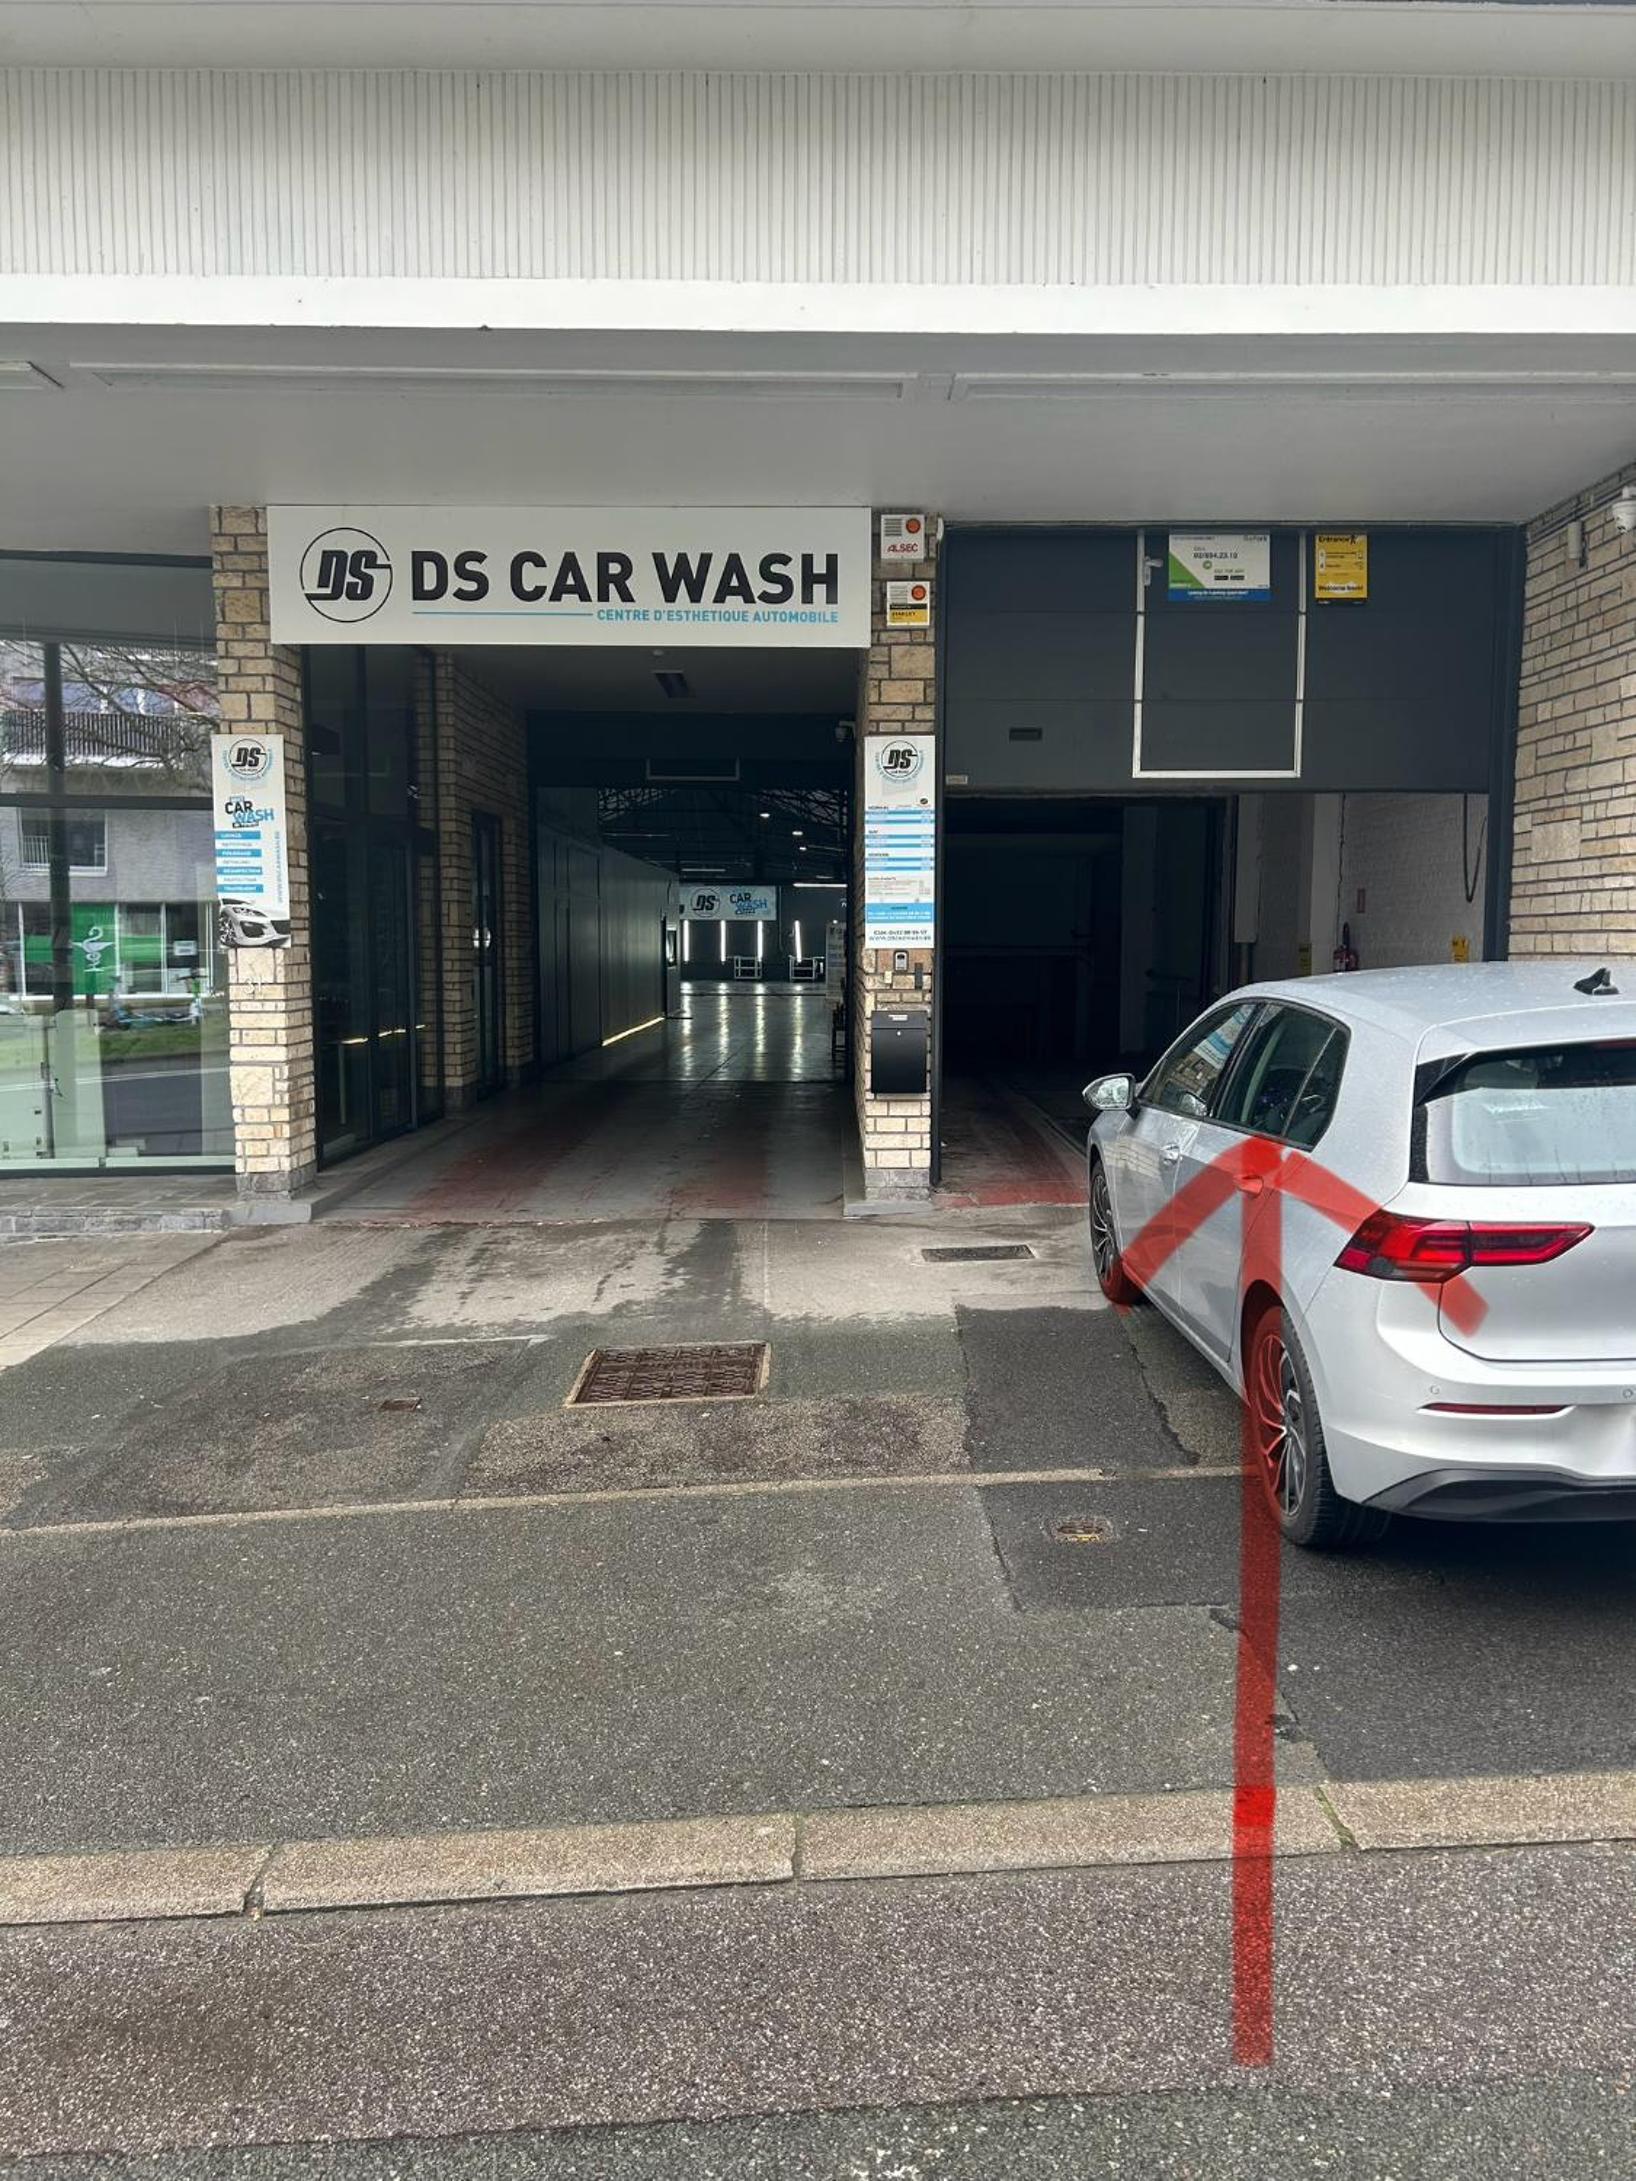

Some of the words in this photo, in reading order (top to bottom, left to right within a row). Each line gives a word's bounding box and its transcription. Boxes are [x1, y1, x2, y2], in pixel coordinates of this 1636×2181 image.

[887, 542, 918, 553] ALSEC
[304, 549, 391, 602] DS
[411, 550, 490, 602] DS
[509, 551, 634, 603] CAR
[651, 552, 838, 605] WASH
[597, 608, 650, 622] CENTRE
[654, 609, 749, 623] D'ESTHETIQUE
[752, 610, 838, 623] AUTOMOBILE
[231, 747, 266, 767] DS
[883, 749, 917, 769] DS
[225, 800, 254, 815] CAR
[234, 808, 275, 824] WASH
[729, 892, 752, 904] CAR
